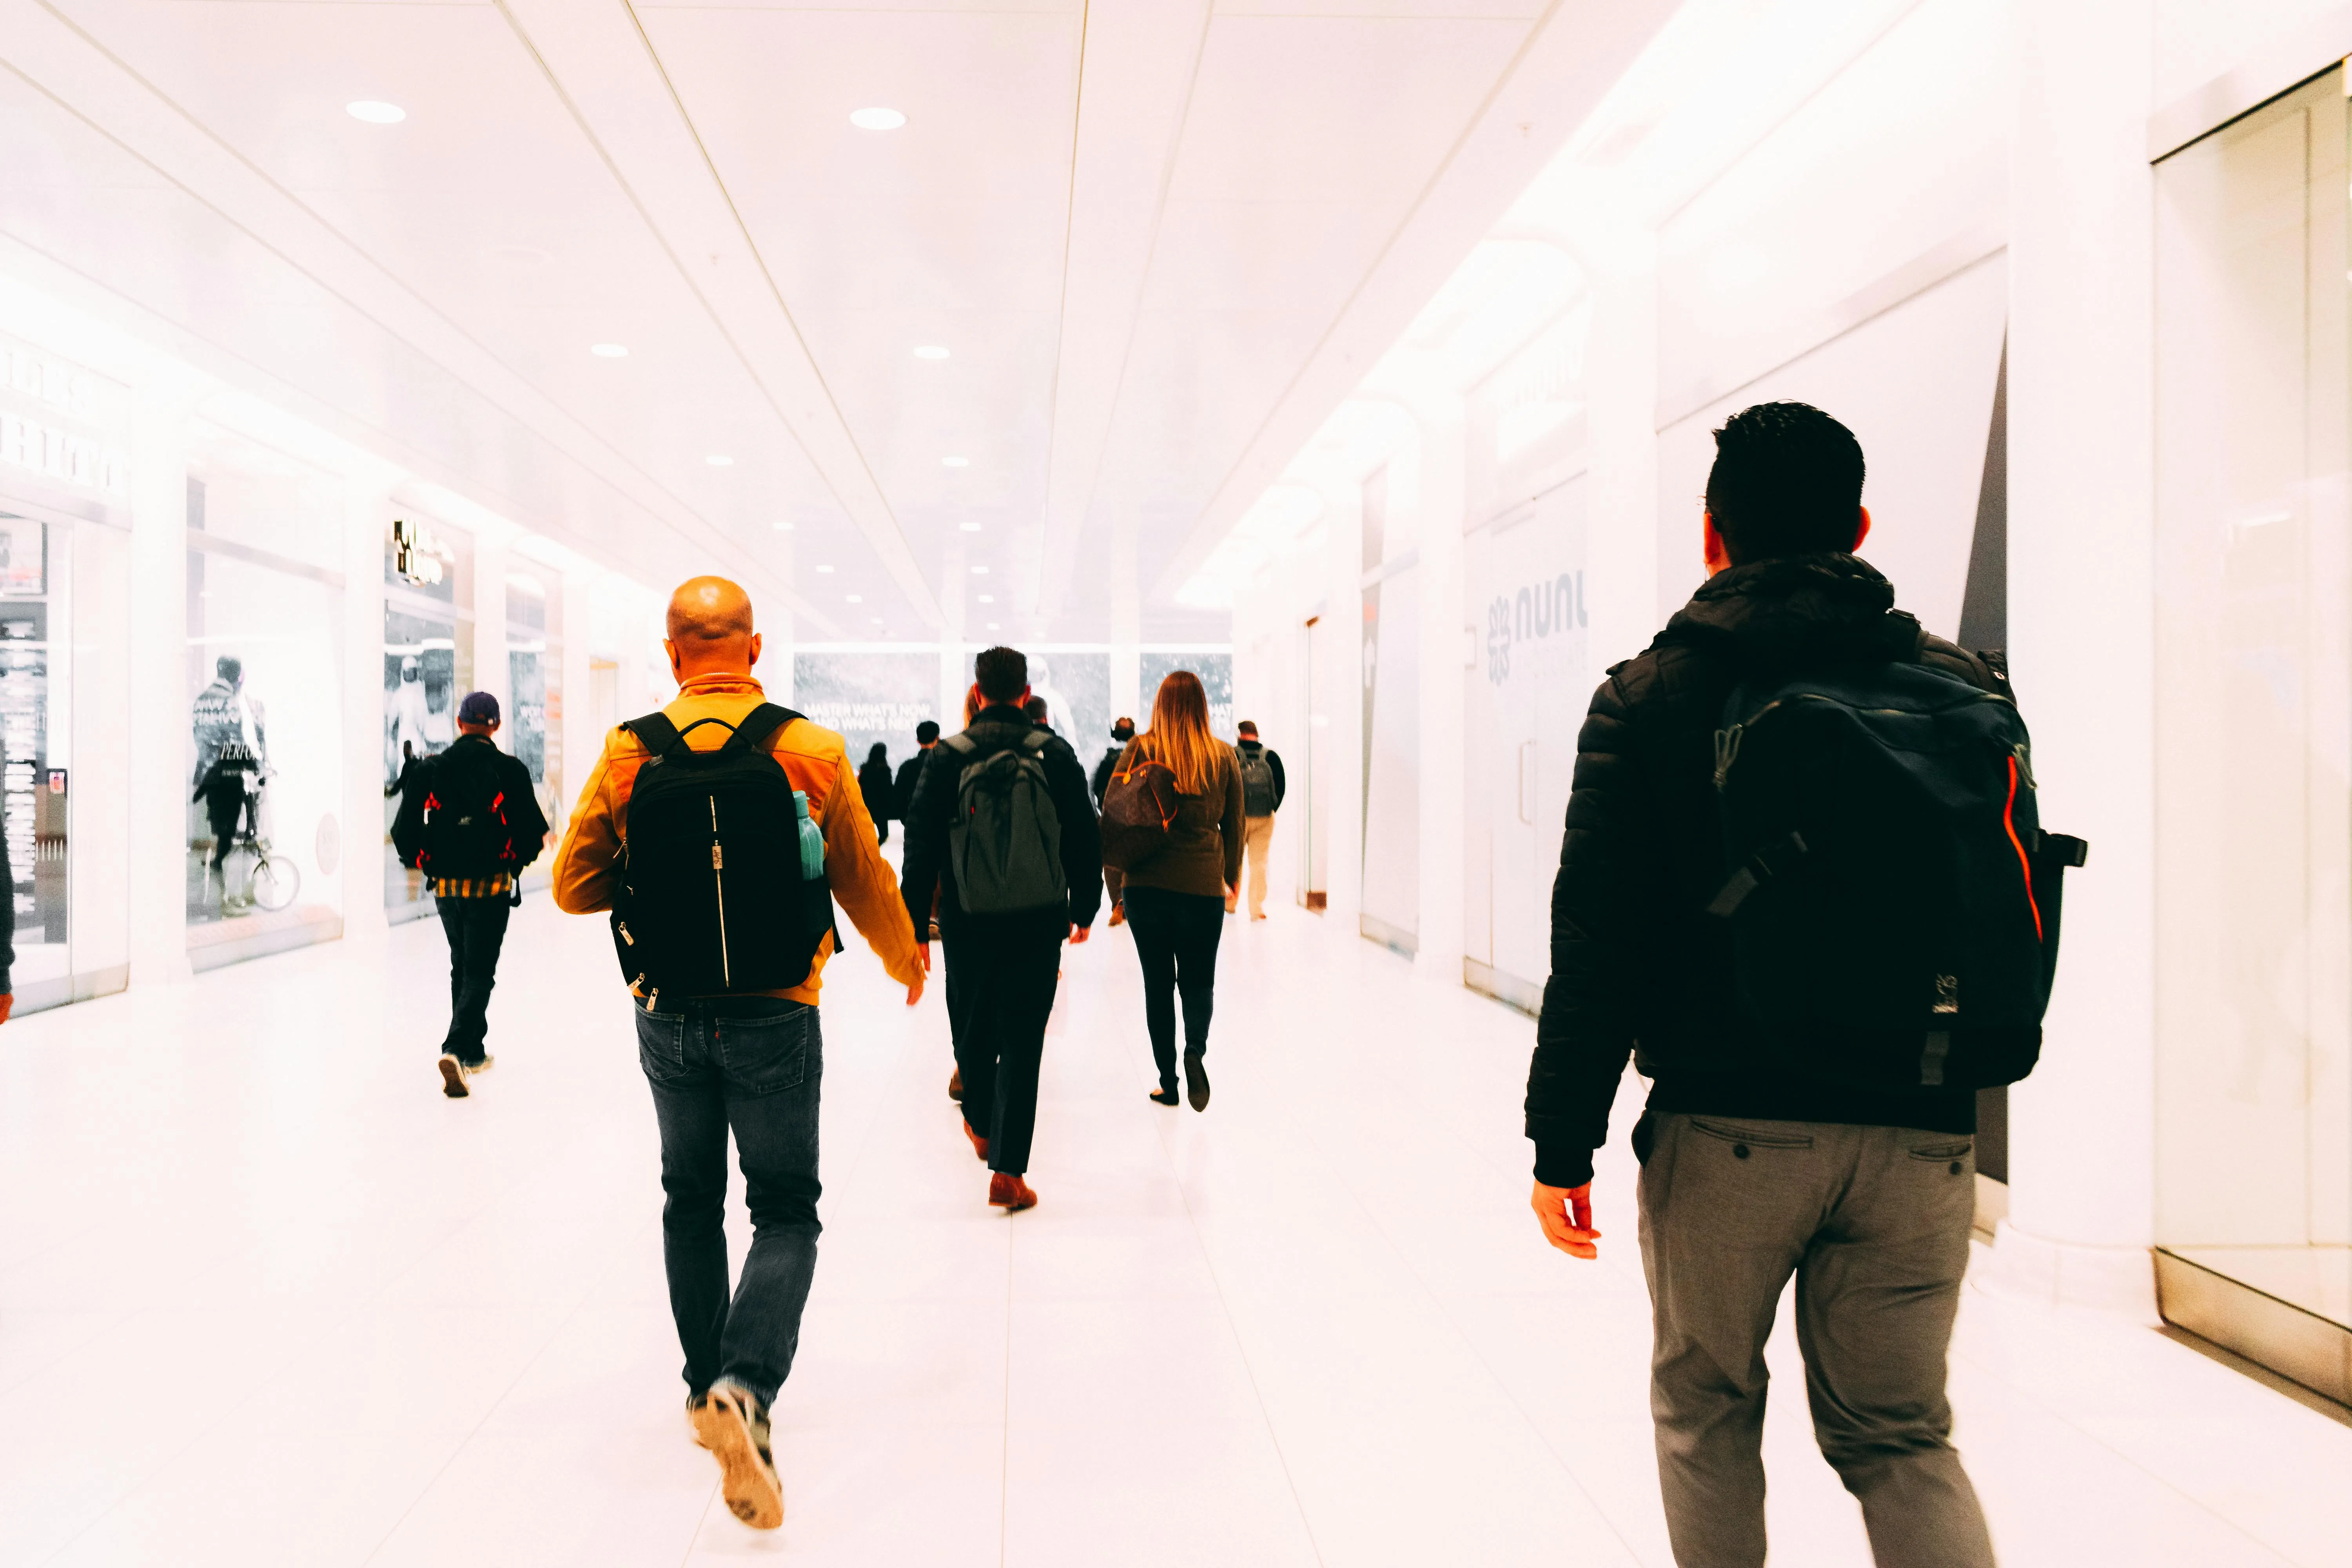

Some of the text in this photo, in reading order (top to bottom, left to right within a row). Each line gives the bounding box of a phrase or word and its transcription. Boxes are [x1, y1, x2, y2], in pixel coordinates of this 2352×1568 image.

[804, 703, 931, 717] MASTER WHAT'S NOW
[841, 717, 886, 731] WHAT'S
